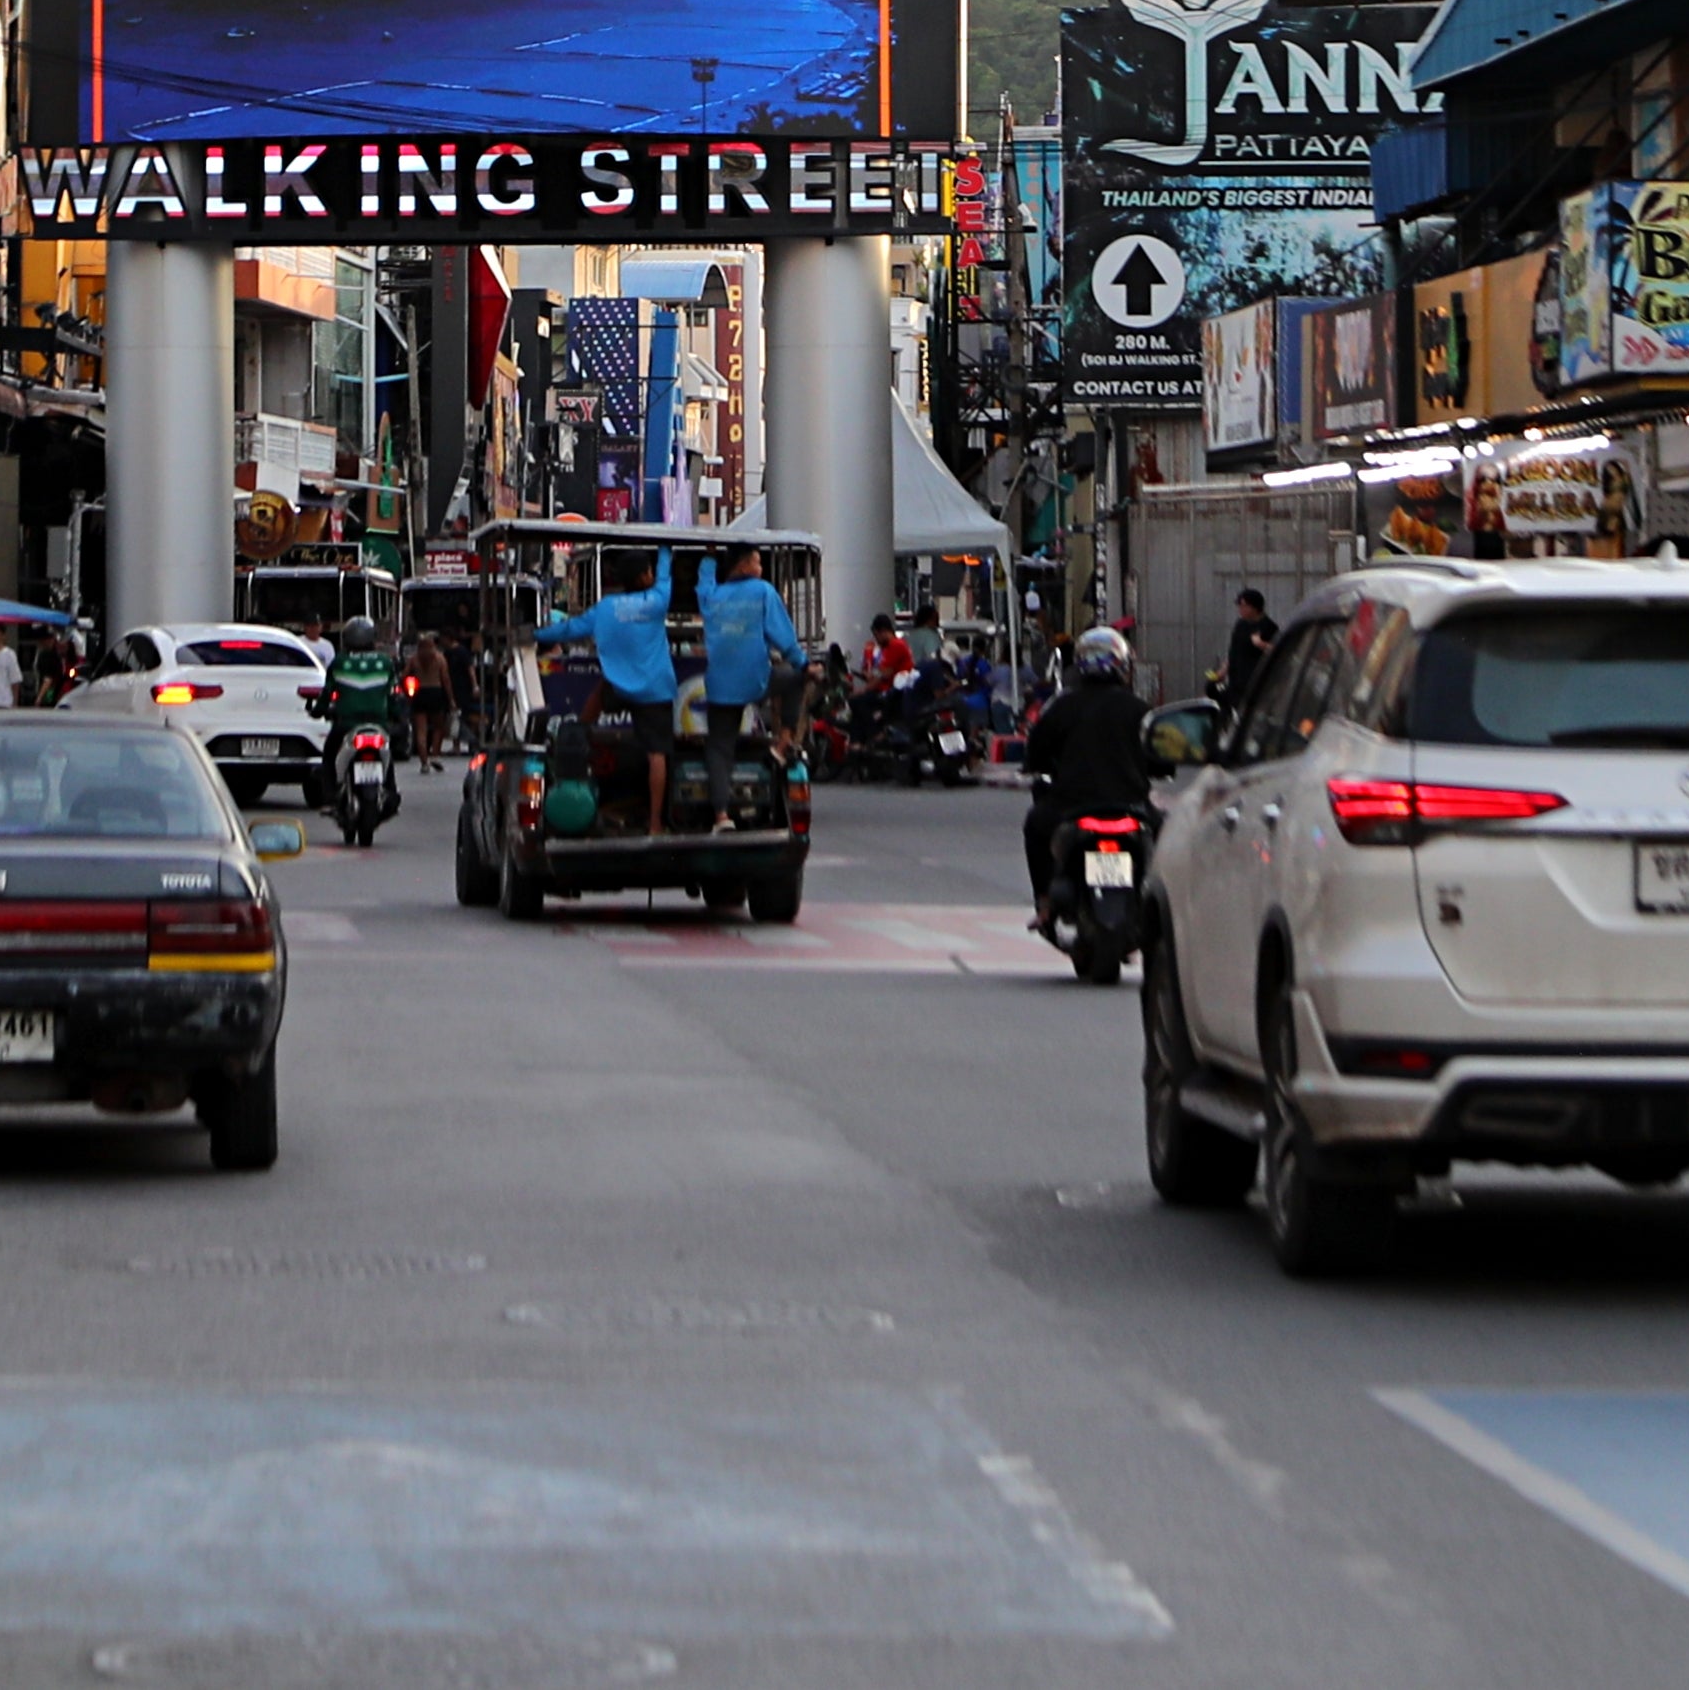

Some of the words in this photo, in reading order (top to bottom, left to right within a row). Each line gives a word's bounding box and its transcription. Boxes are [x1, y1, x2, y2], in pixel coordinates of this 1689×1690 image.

[1214, 134, 1371, 159] PATTAYA
[20, 143, 537, 218] WALKING
[579, 141, 952, 216] STREET
[1101, 190, 1220, 208] THAILAND'S
[1224, 190, 1309, 208] BIGGEST
[1114, 334, 1148, 350] 280
[1149, 334, 1171, 350] M.
[1124, 354, 1180, 366] WALKING
[1073, 380, 1155, 396] CONTACT
[1156, 380, 1180, 396] US
[1181, 380, 1204, 396] AT
[160, 872, 212, 890] TOYOTA
